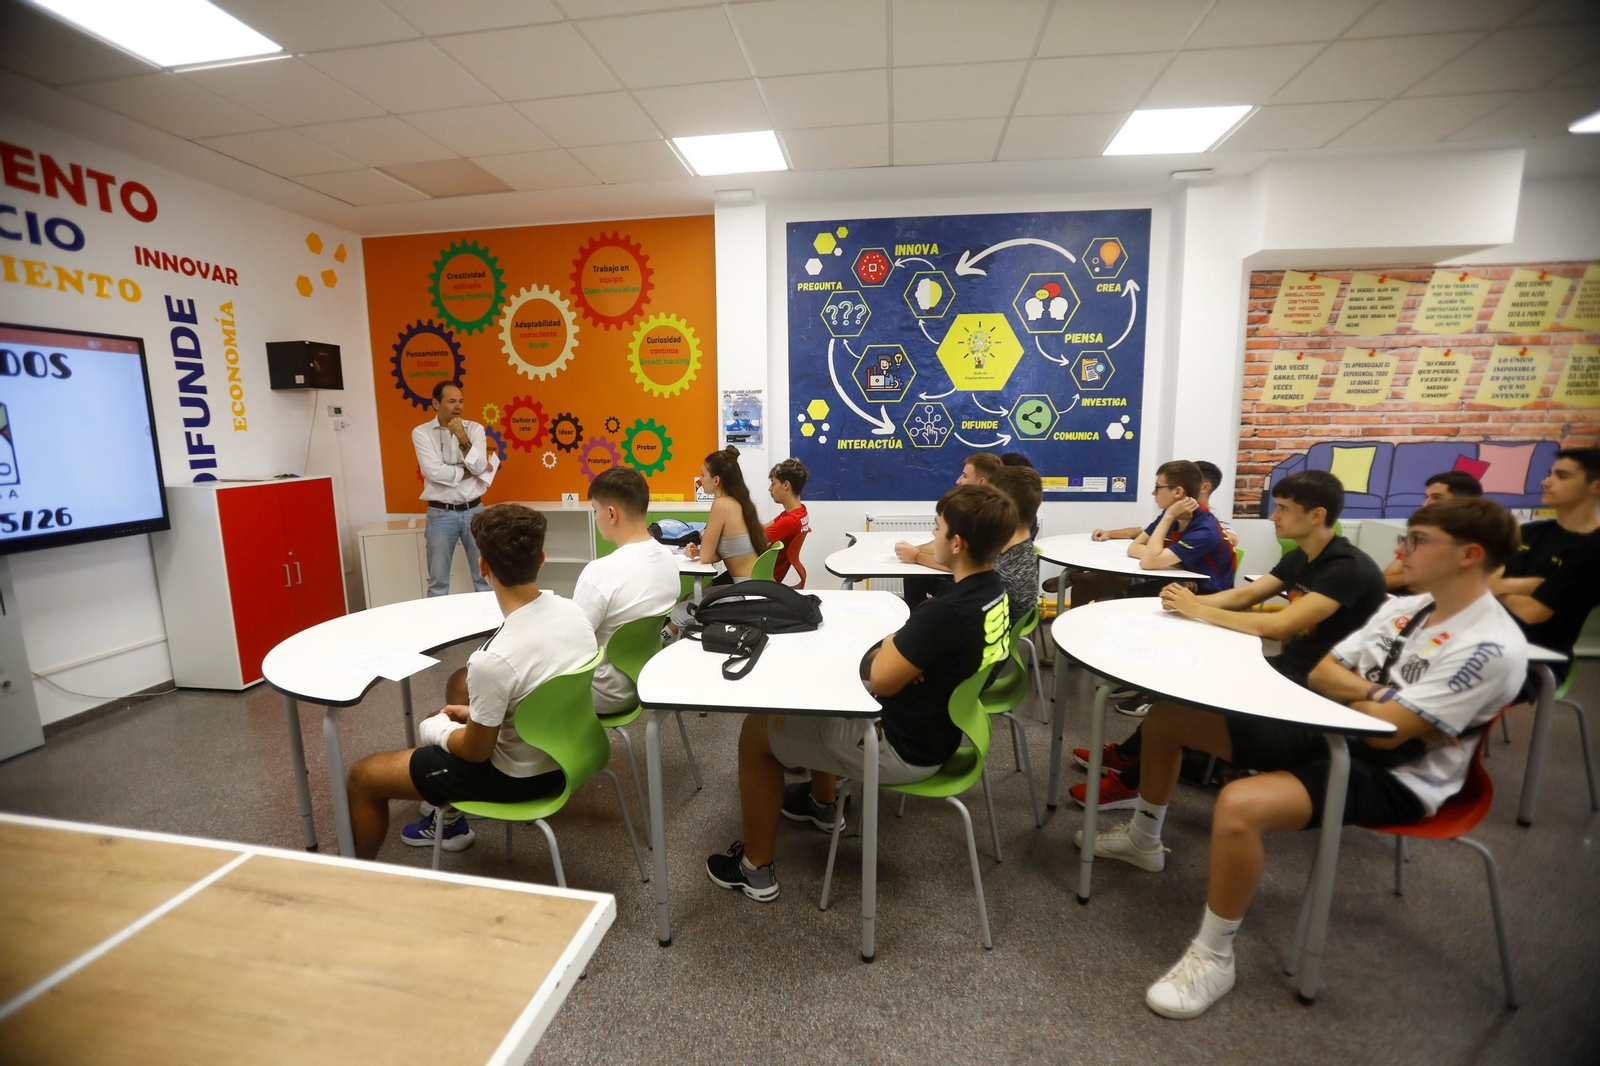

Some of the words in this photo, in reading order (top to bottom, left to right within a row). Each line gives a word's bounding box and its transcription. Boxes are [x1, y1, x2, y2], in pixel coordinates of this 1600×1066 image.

[894, 244, 939, 256] INNOVA
[134, 246, 239, 286] INNOVAR
[592, 265, 619, 274] Trabajo
[447, 271, 486, 280] Creatividad
[600, 276, 624, 284] equipo
[453, 282, 481, 290] aplicada
[797, 282, 843, 292] PREGUNTA
[1096, 284, 1122, 292] CREA
[514, 320, 561, 330] Adaptabilidad
[1064, 334, 1104, 344] PIENSA
[406, 350, 448, 358] Pensamiento
[650, 346, 678, 354] continua
[214, 300, 248, 432] ECONOMÍA
[664, 358, 690, 366] hacking
[1081, 398, 1127, 406] INVESTIGA
[961, 420, 998, 430] DIFUNDE
[1053, 432, 1100, 441] COMUNICA
[837, 437, 903, 450] INTERACTÚA
[1448, 642, 1504, 693] Kicaldo
